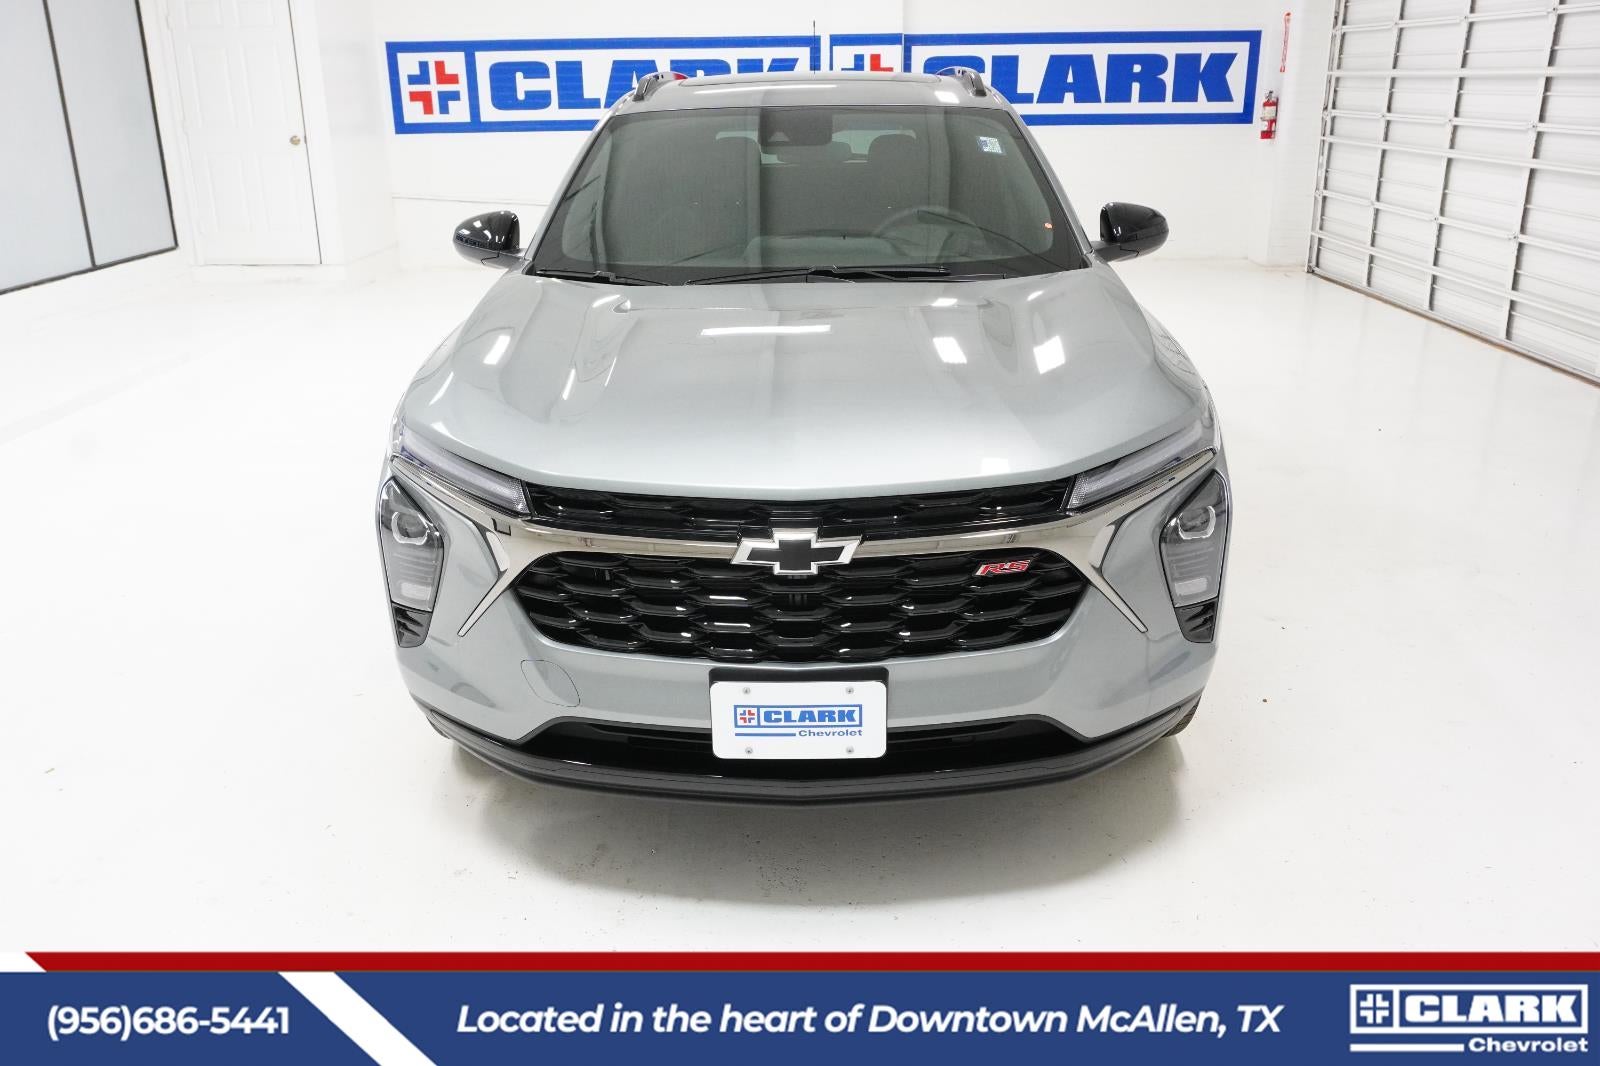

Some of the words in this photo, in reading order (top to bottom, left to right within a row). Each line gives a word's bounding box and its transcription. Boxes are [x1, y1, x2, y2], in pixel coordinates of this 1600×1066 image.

[488, 56, 799, 111] CLA
[975, 559, 1031, 576] RS
[763, 709, 857, 723] CLARK
[798, 729, 863, 737] Chevrolet
